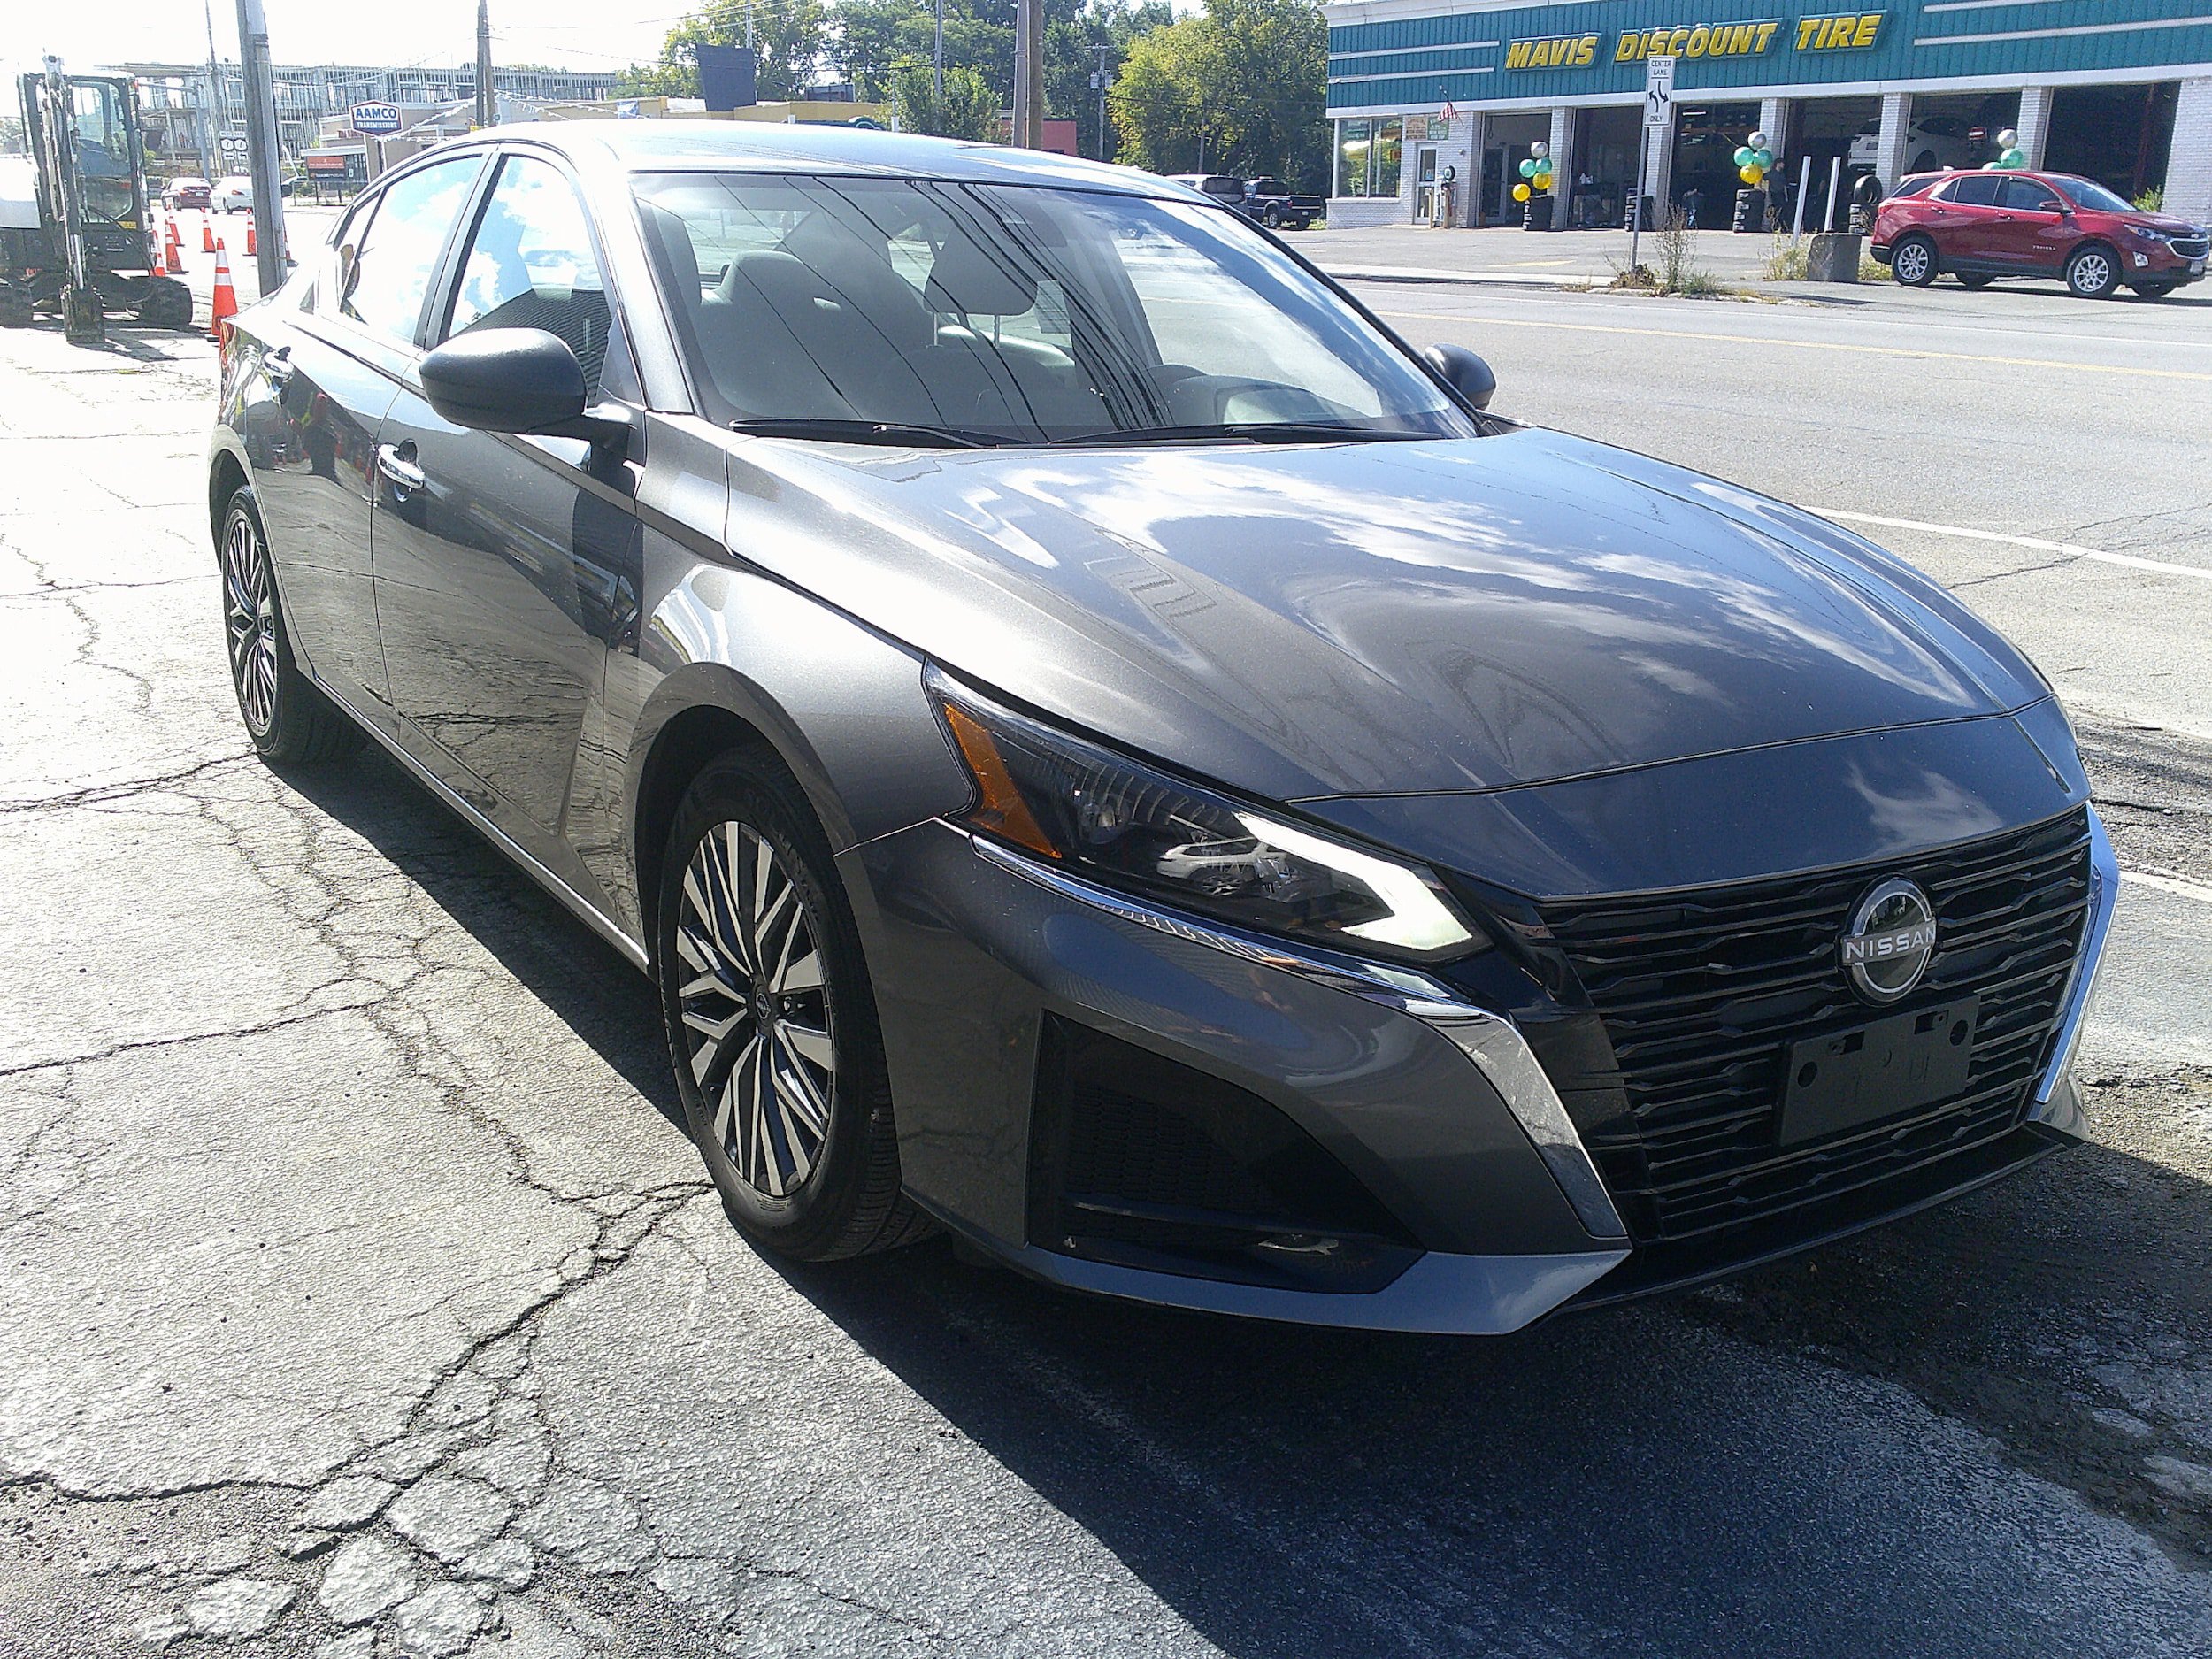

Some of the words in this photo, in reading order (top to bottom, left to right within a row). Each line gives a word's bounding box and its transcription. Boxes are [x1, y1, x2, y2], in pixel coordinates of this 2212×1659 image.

[1506, 36, 1598, 69] MAVIS
[1615, 22, 1778, 62] DISCOUNT
[1797, 14, 1883, 50] TIRE
[356, 108, 396, 119] AAMCO
[1846, 924, 1936, 959] NISSAN
